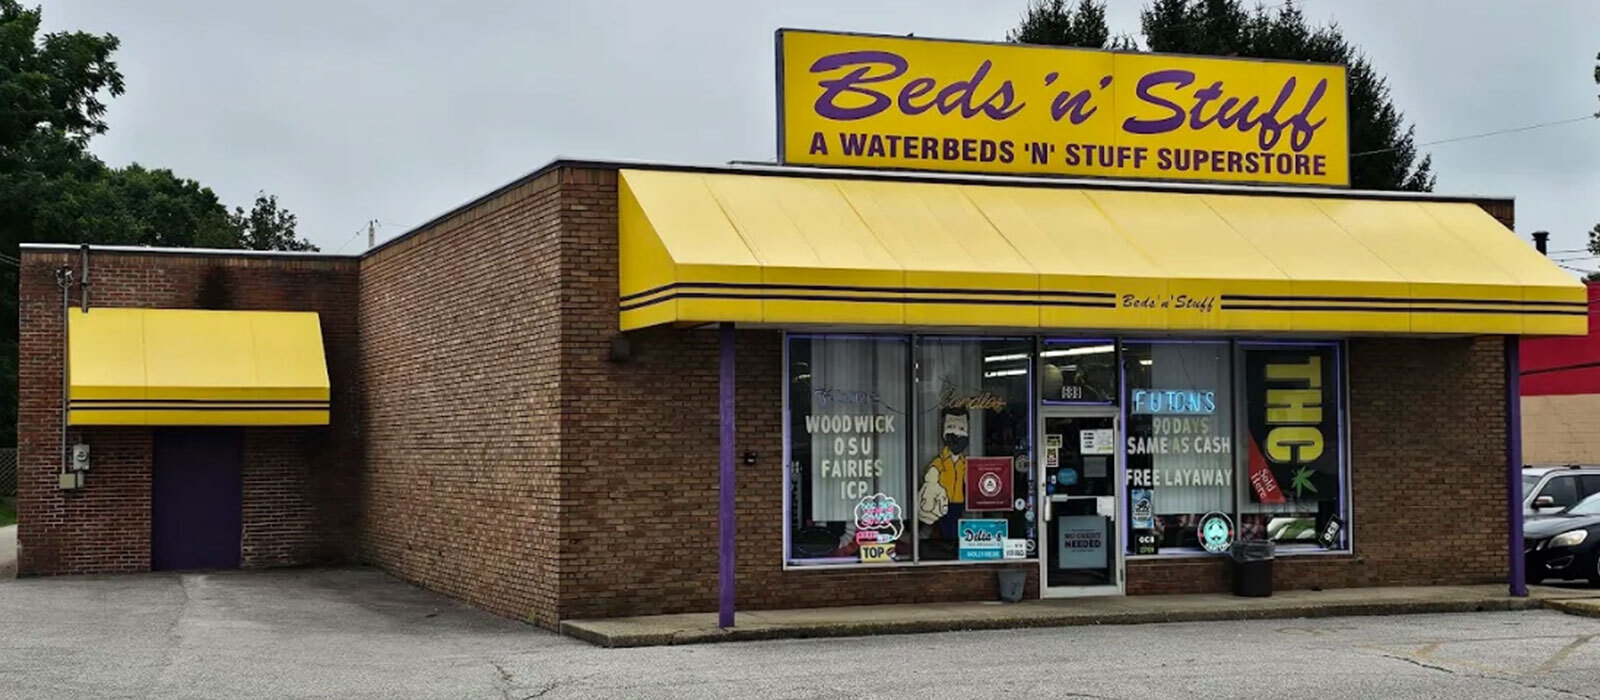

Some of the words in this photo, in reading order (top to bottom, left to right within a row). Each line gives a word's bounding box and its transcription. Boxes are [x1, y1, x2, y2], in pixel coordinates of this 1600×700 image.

[809, 50, 1026, 121] Beds
[1122, 69, 1328, 153] Stuff
[809, 131, 829, 156] A
[839, 132, 1015, 164] WATERBEDS
[1025, 142, 1055, 165] 'N'
[1065, 143, 1148, 169] STUFF
[1157, 148, 1327, 176] SUPERSTORE
[1122, 294, 1155, 308] Beds
[1174, 294, 1215, 313] Stuff
[1135, 391, 1215, 412] FUTONS
[1265, 356, 1324, 462] THC
[1127, 436, 1168, 454] SAME
[1172, 437, 1190, 453] AS
[1194, 437, 1231, 454] CASH
[821, 459, 884, 478] FAIRIES
[1125, 469, 1160, 486] FREE
[1165, 469, 1232, 486] LAYAWAY
[1250, 472, 1268, 499] Here
[1259, 468, 1277, 492] Sold
[841, 481, 868, 499] ICP
[862, 546, 884, 559] TOP
[1064, 539, 1102, 549] NEEDED
